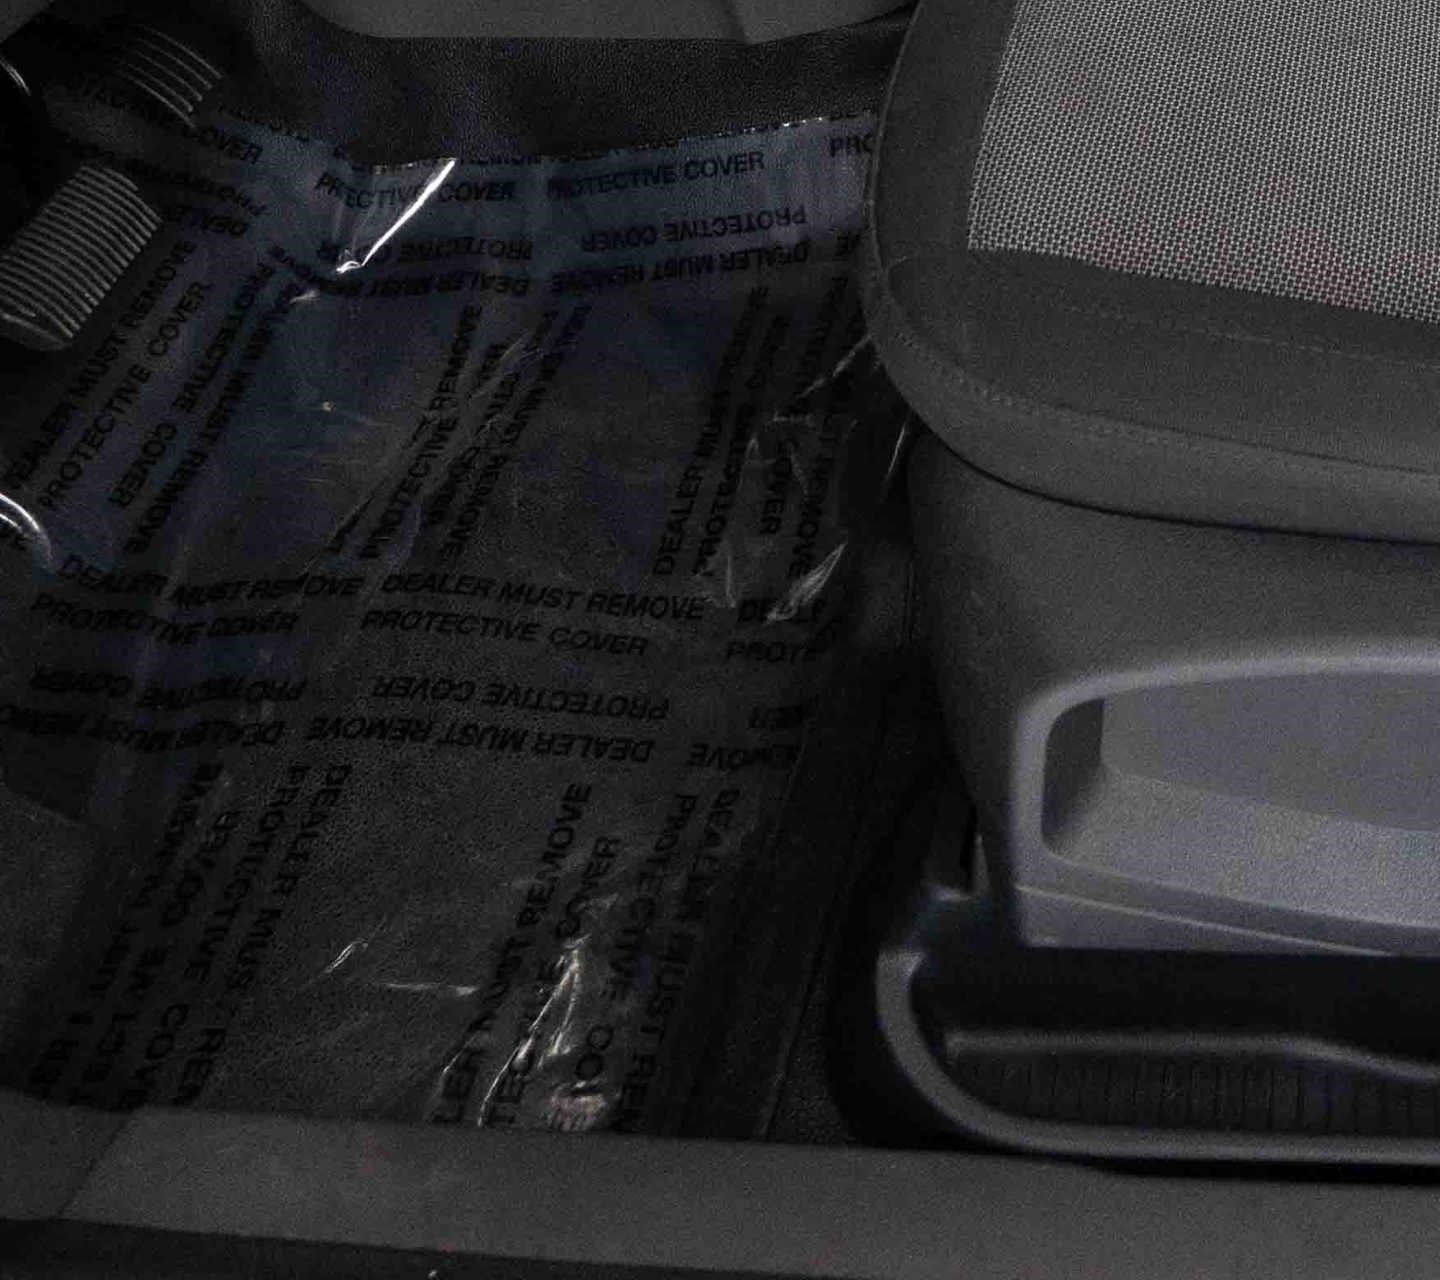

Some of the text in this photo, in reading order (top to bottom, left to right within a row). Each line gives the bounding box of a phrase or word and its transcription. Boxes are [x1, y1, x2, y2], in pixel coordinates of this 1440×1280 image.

[682, 150, 766, 182] COVER
[581, 205, 808, 254] PROTECTIVE COVER
[719, 238, 810, 272] DEALER
[118, 239, 197, 330] REMOVE
[651, 251, 716, 283] MUST
[37, 362, 152, 511] PROTECTIVE
[148, 281, 211, 358] COVER
[107, 422, 178, 509] COVER
[651, 463, 704, 576] DEALER
[381, 571, 709, 622] DEALER MUST REMOVE
[359, 608, 651, 658] PROTECTIVE COVER
[371, 675, 671, 721] PROTECTIVE COVER
[305, 714, 657, 765] DEALER MUST REMOVE
[271, 763, 354, 897] DEALER
[515, 781, 595, 930] REMOVE
[182, 763, 311, 984] PROTECTIVE
